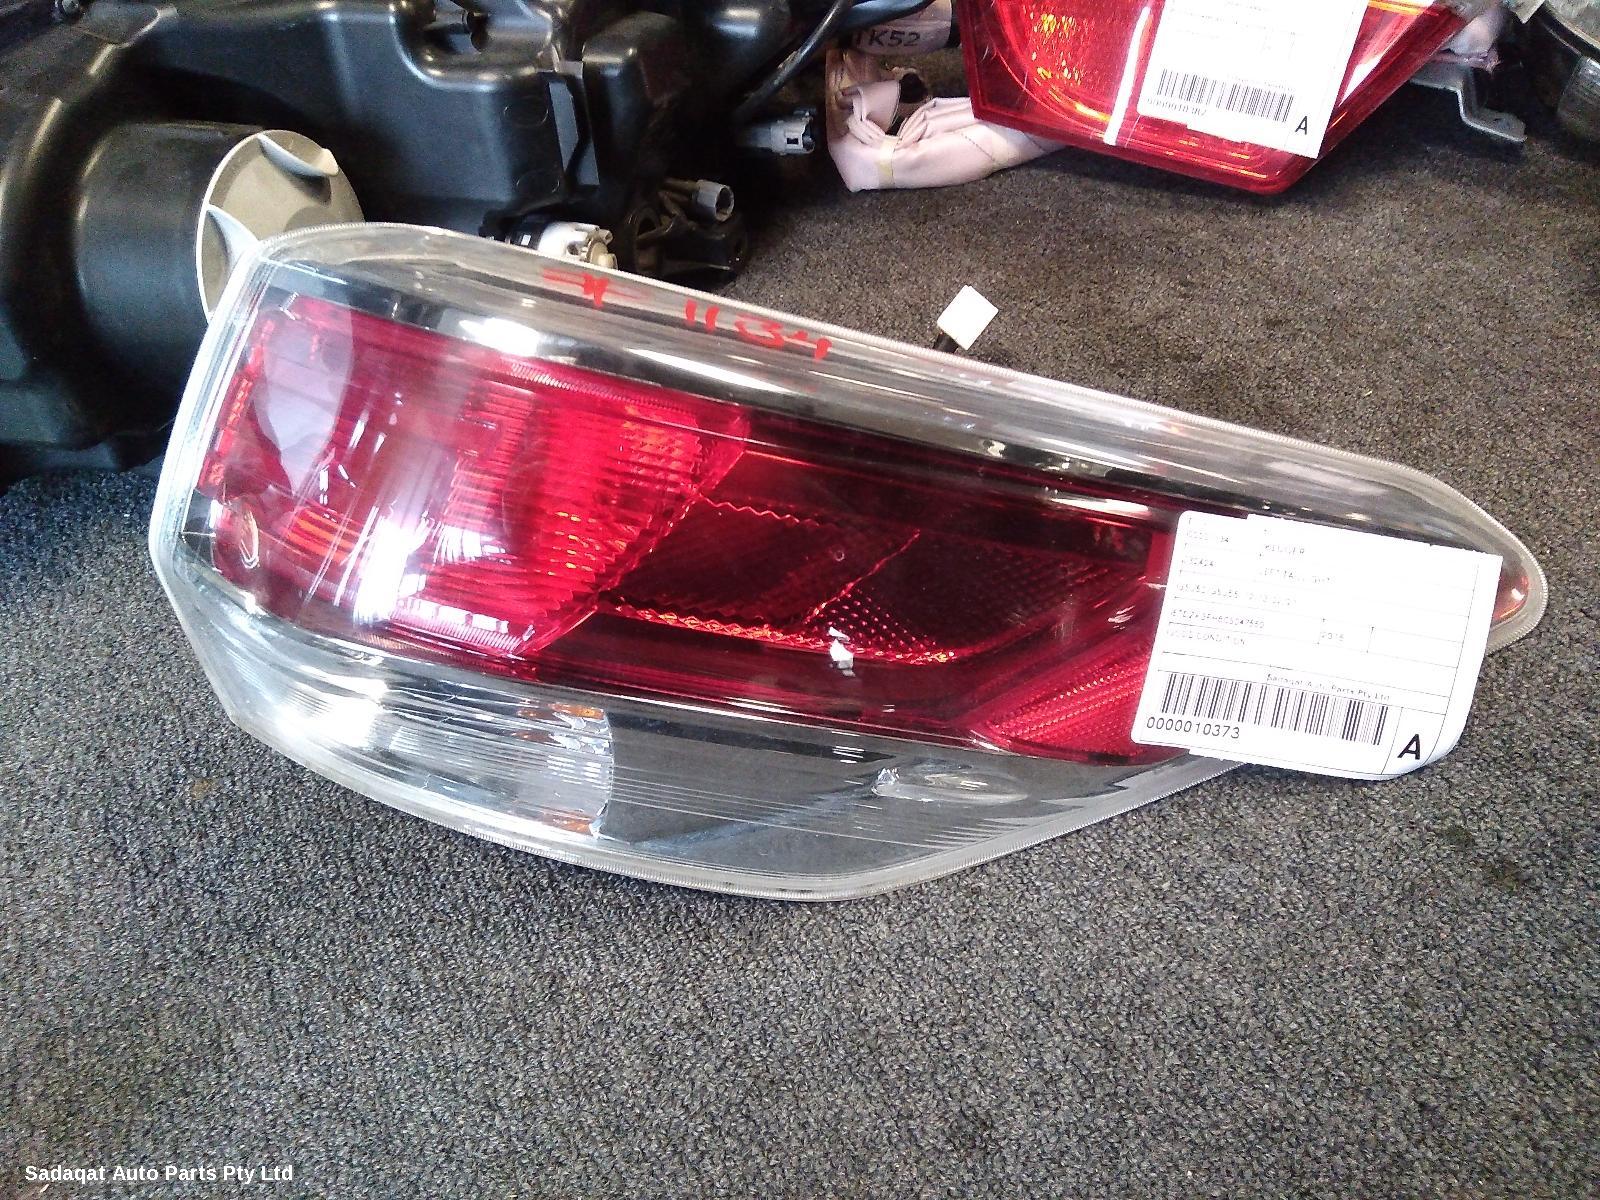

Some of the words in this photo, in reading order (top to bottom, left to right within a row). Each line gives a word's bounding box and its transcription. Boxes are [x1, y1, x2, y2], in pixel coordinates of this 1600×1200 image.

[1295, 115, 1308, 135] A
[1146, 716, 1240, 740] 0000010373
[1397, 733, 1421, 760] A
